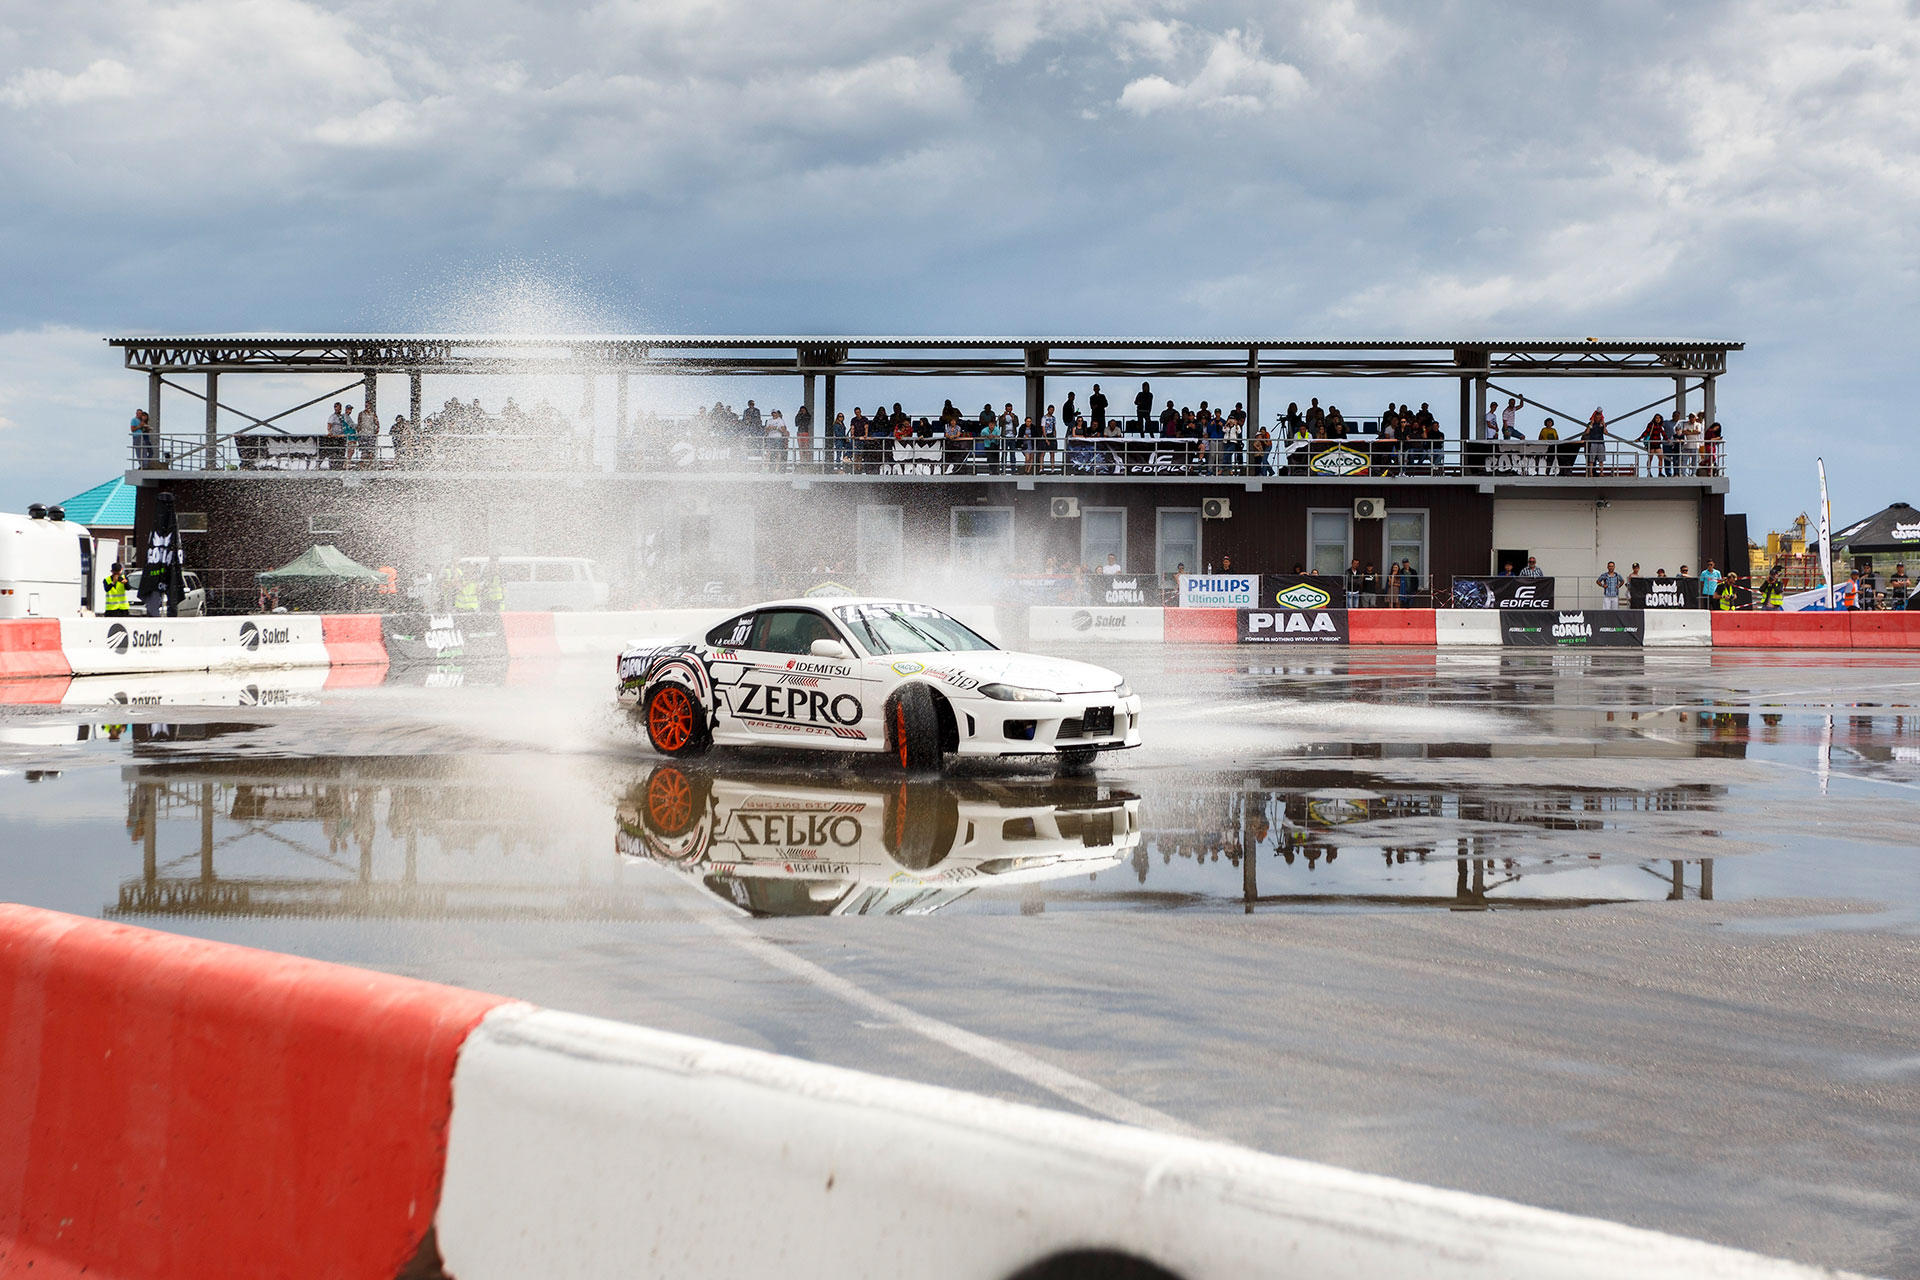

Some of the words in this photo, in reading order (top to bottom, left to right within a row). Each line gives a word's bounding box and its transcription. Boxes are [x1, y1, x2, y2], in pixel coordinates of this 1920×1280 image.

[1320, 457, 1362, 468] YACCO
[1188, 579, 1250, 592] PHILIPS
[1105, 590, 1145, 603] GORILLA
[1188, 594, 1225, 604] Ultinon
[1228, 594, 1250, 604] LED
[1285, 594, 1322, 603] YACCO
[1500, 599, 1550, 608] EDIFICE
[1645, 592, 1685, 607] GORILLA
[1094, 614, 1126, 628] Sokol
[1248, 612, 1336, 633] PIAA
[262, 627, 290, 645] Sokol
[731, 624, 753, 642] 101
[1552, 623, 1593, 637] GORILLA
[132, 629, 163, 648] Sokol
[795, 662, 851, 676] IDEMITSU
[897, 664, 921, 674] YACCO
[737, 683, 863, 726] ZEPRO
[747, 720, 801, 731] RACING
[805, 727, 832, 736] OIL
